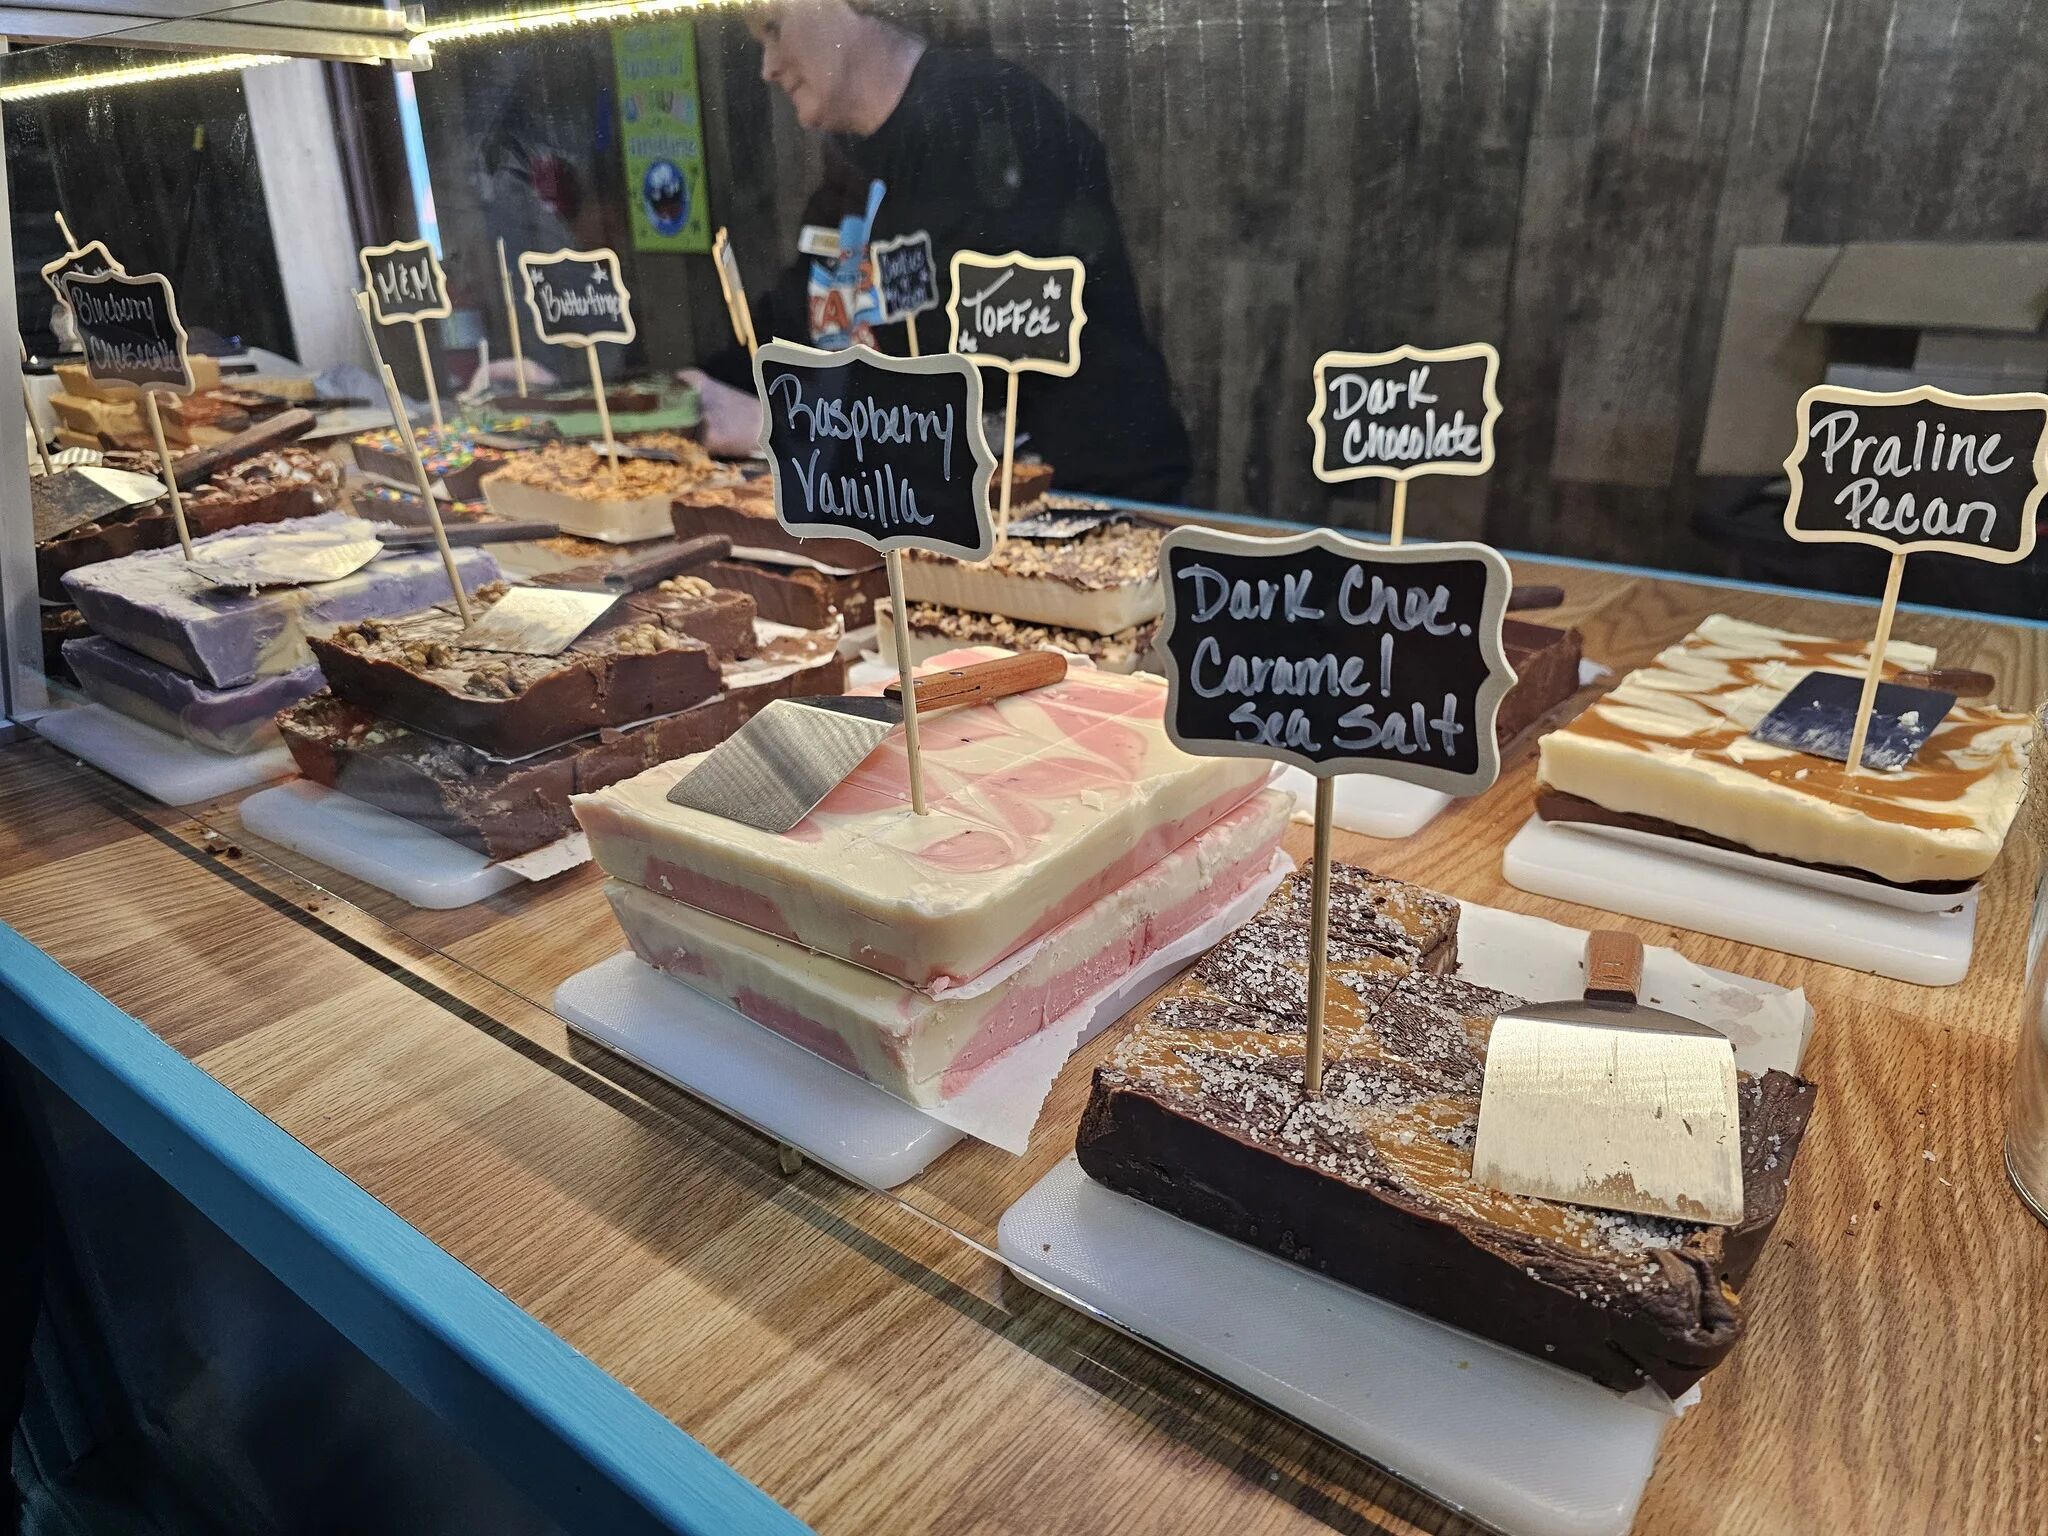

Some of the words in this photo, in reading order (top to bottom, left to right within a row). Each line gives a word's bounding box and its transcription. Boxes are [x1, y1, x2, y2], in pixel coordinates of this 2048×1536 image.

[71, 286, 160, 339] Blueberry
[1328, 364, 1439, 421] Dark
[769, 373, 954, 482] Raspberry
[1342, 408, 1481, 464] Chocolate
[1809, 409, 2015, 478] Praline
[791, 448, 935, 529] Vanilla
[1833, 477, 1998, 543] Pecan
[1177, 563, 1326, 624] Dark
[1338, 564, 1472, 637] Choc.
[1190, 632, 1394, 699] Caramel
[1228, 701, 1322, 752] Sea
[1332, 692, 1465, 757] Salt
